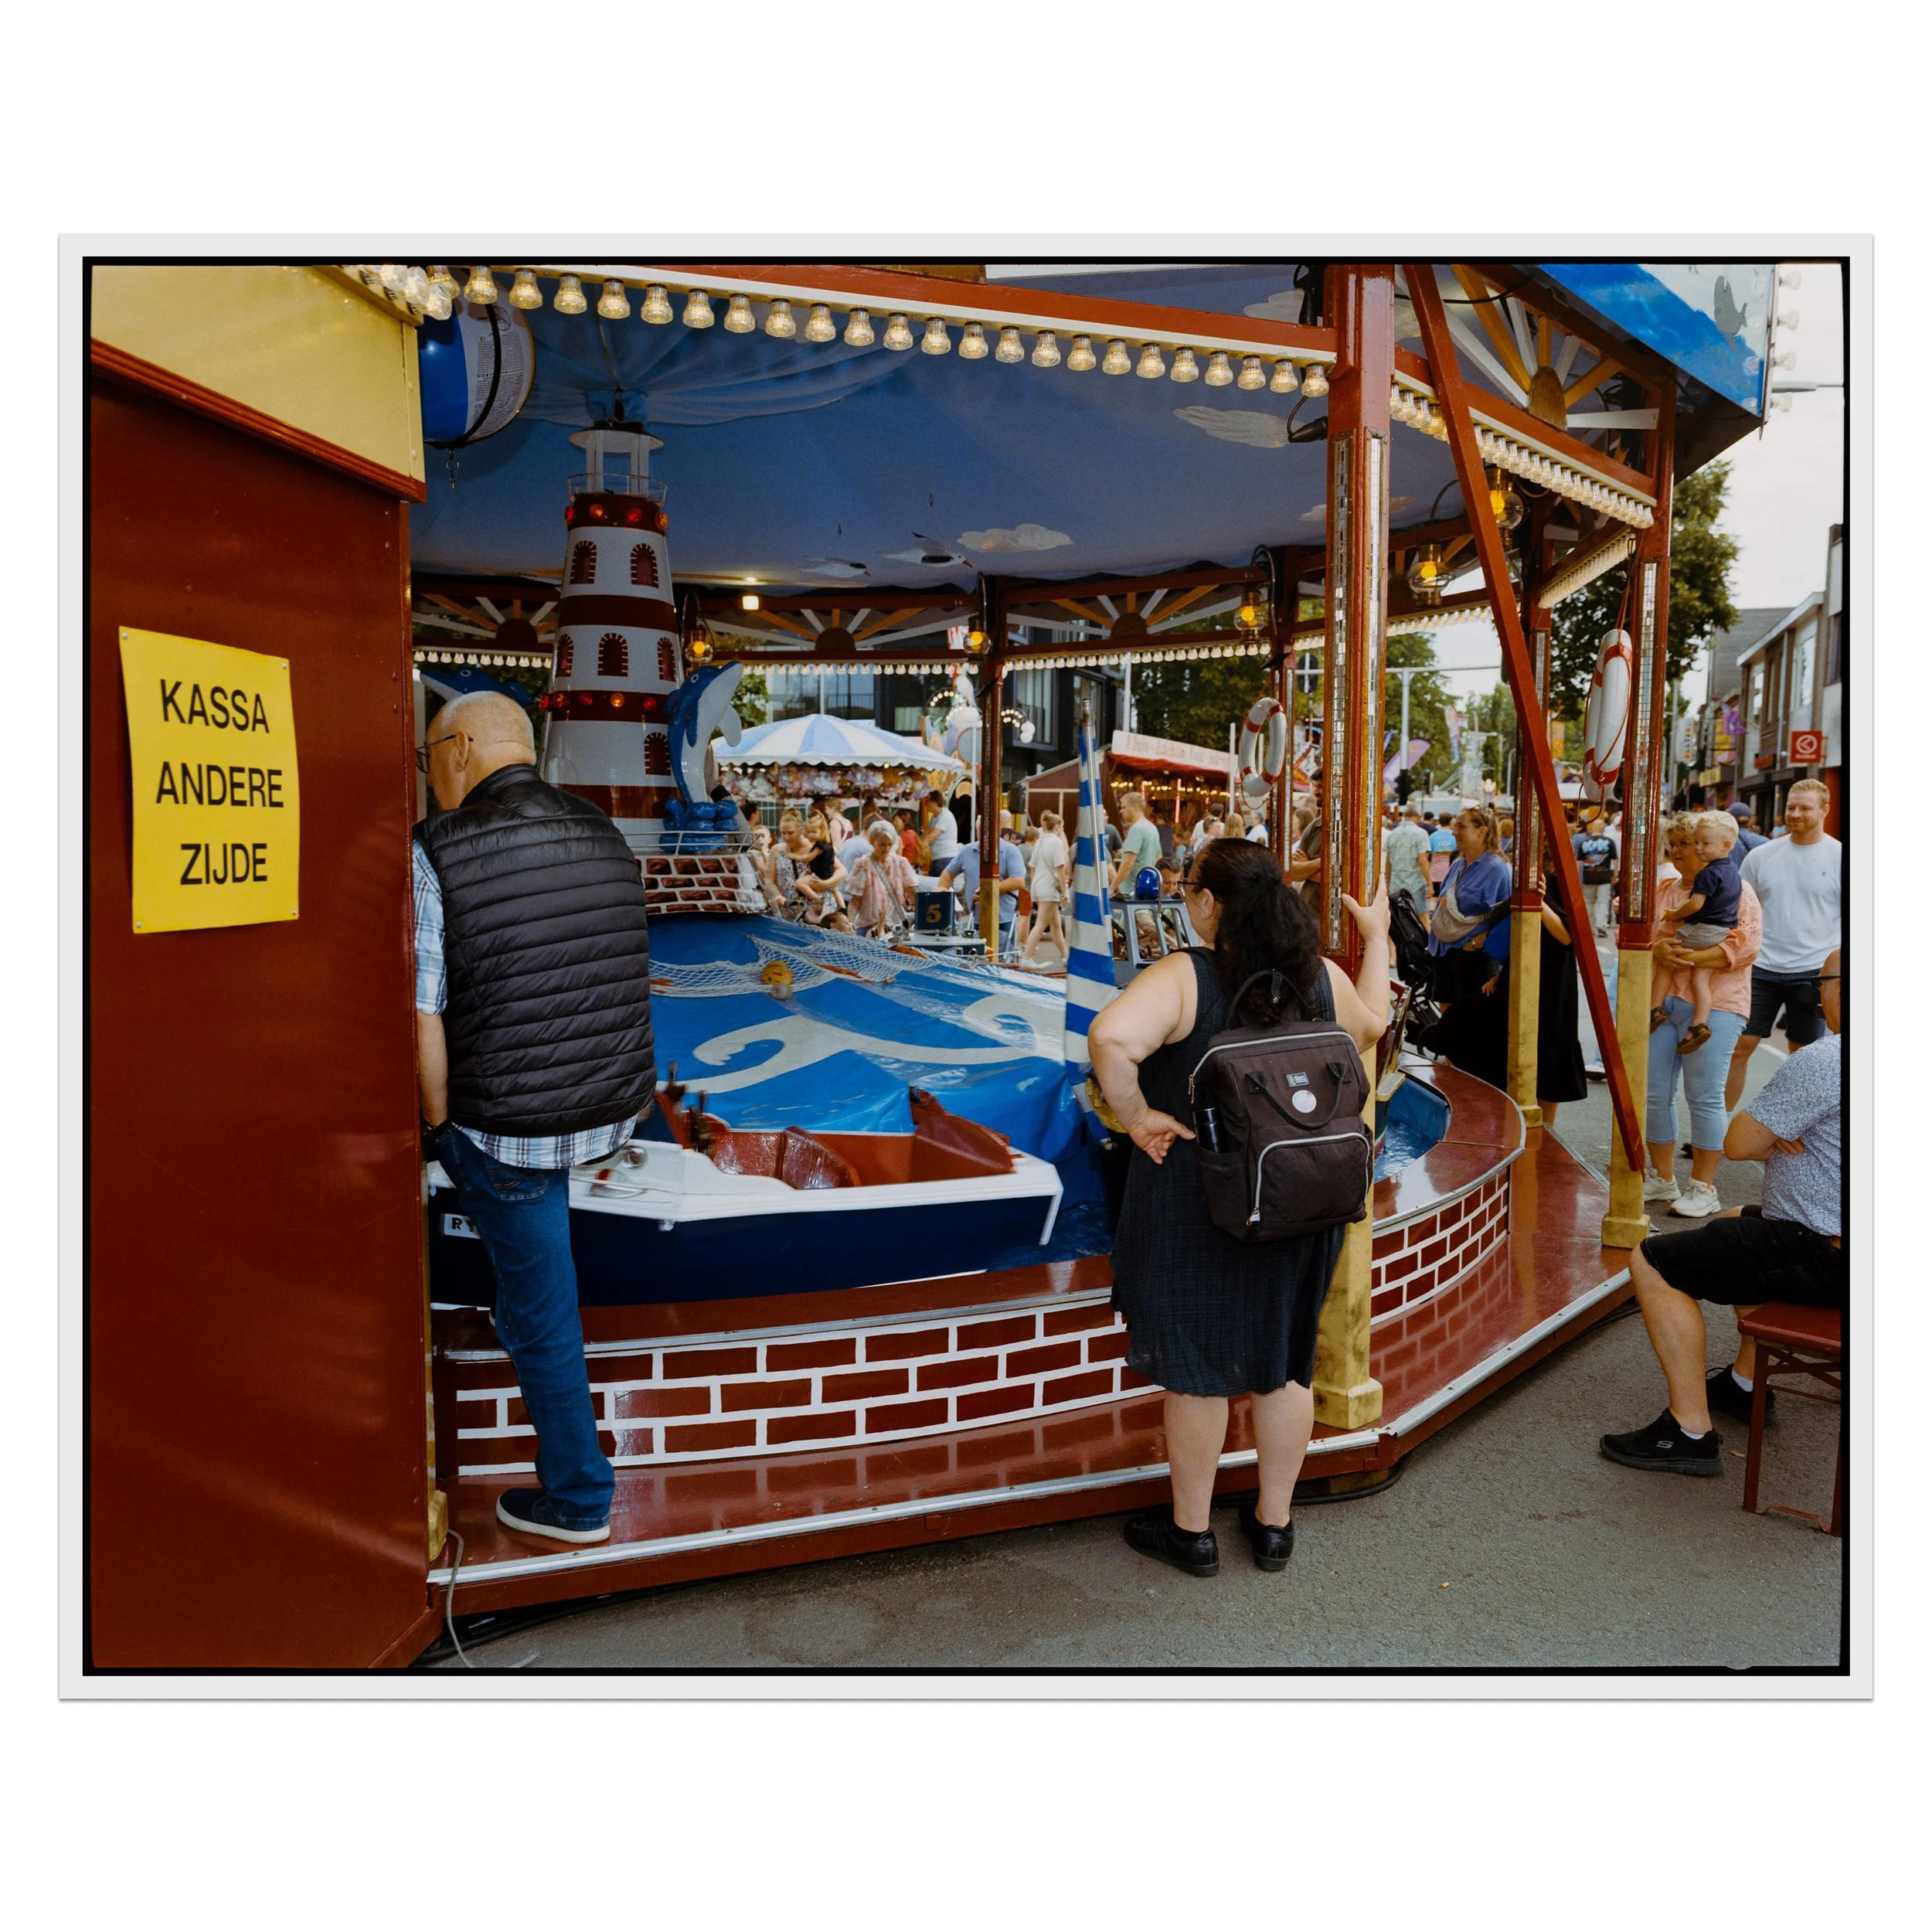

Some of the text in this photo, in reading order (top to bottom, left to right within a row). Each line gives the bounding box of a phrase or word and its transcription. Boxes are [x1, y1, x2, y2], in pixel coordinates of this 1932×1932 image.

[160, 679, 270, 733] KASSA
[156, 761, 284, 808] ANDERE
[180, 843, 267, 885] ZIJDE
[926, 903, 941, 923] 5
